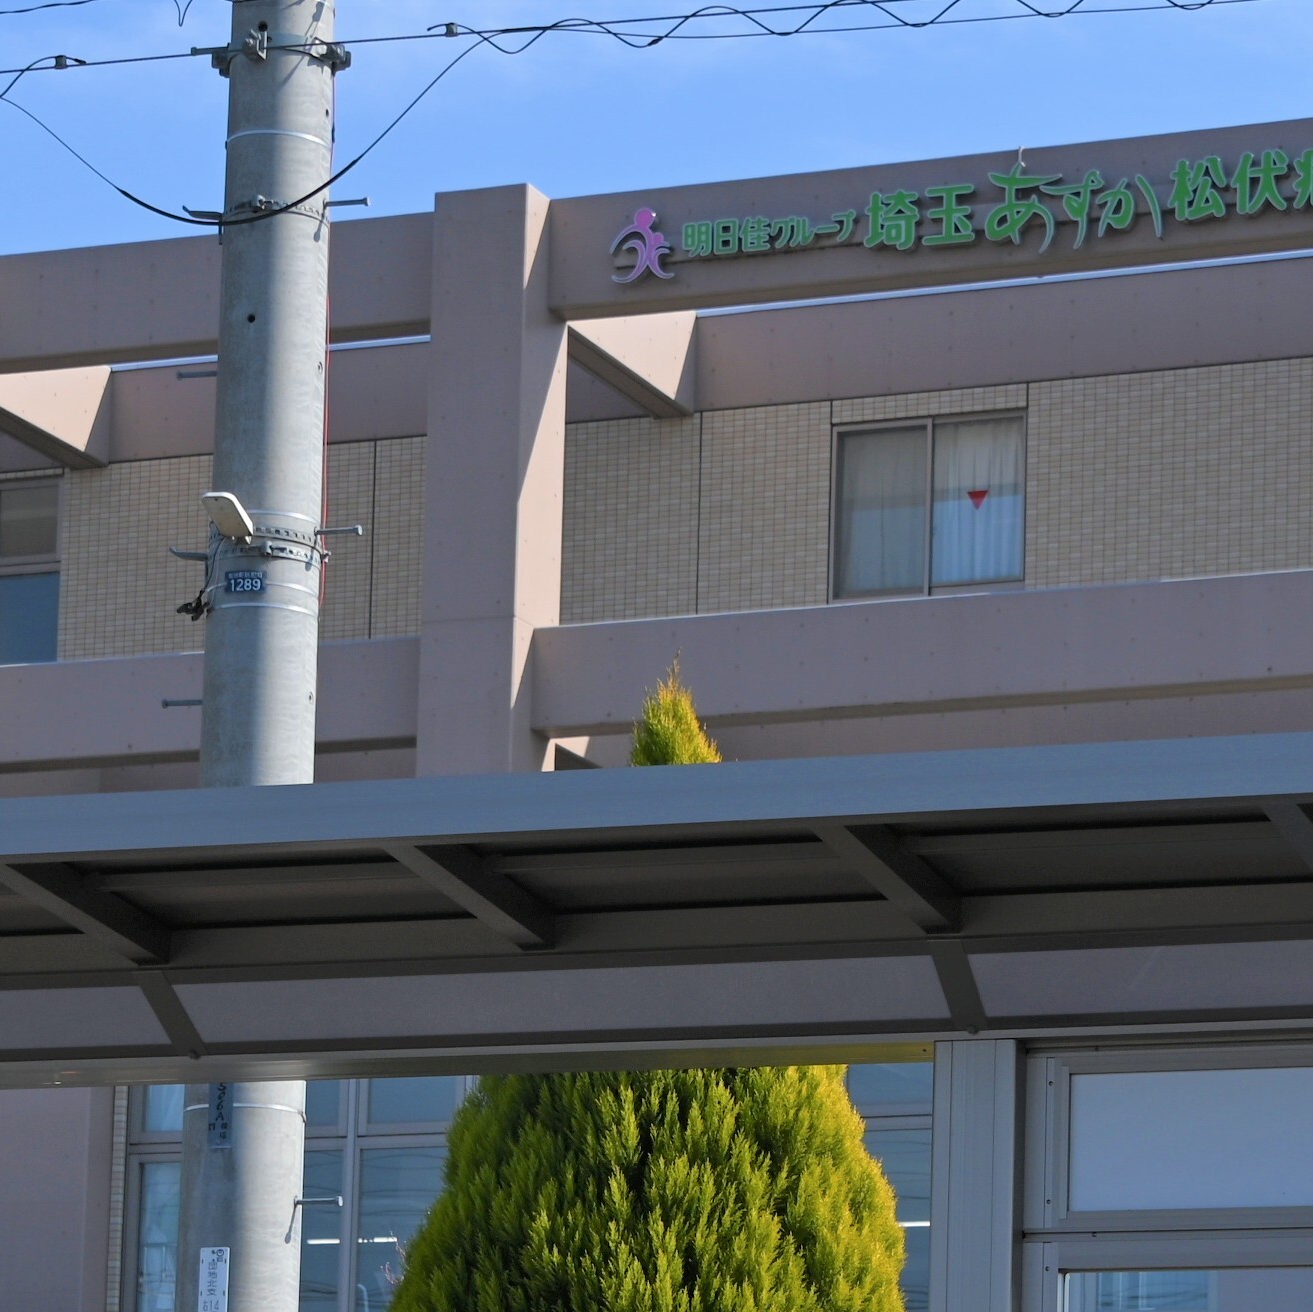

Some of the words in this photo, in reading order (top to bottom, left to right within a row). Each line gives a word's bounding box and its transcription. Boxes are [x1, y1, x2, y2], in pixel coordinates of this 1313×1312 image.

[681, 208, 856, 257] 明日佳グループ
[230, 578, 261, 592] 1289
